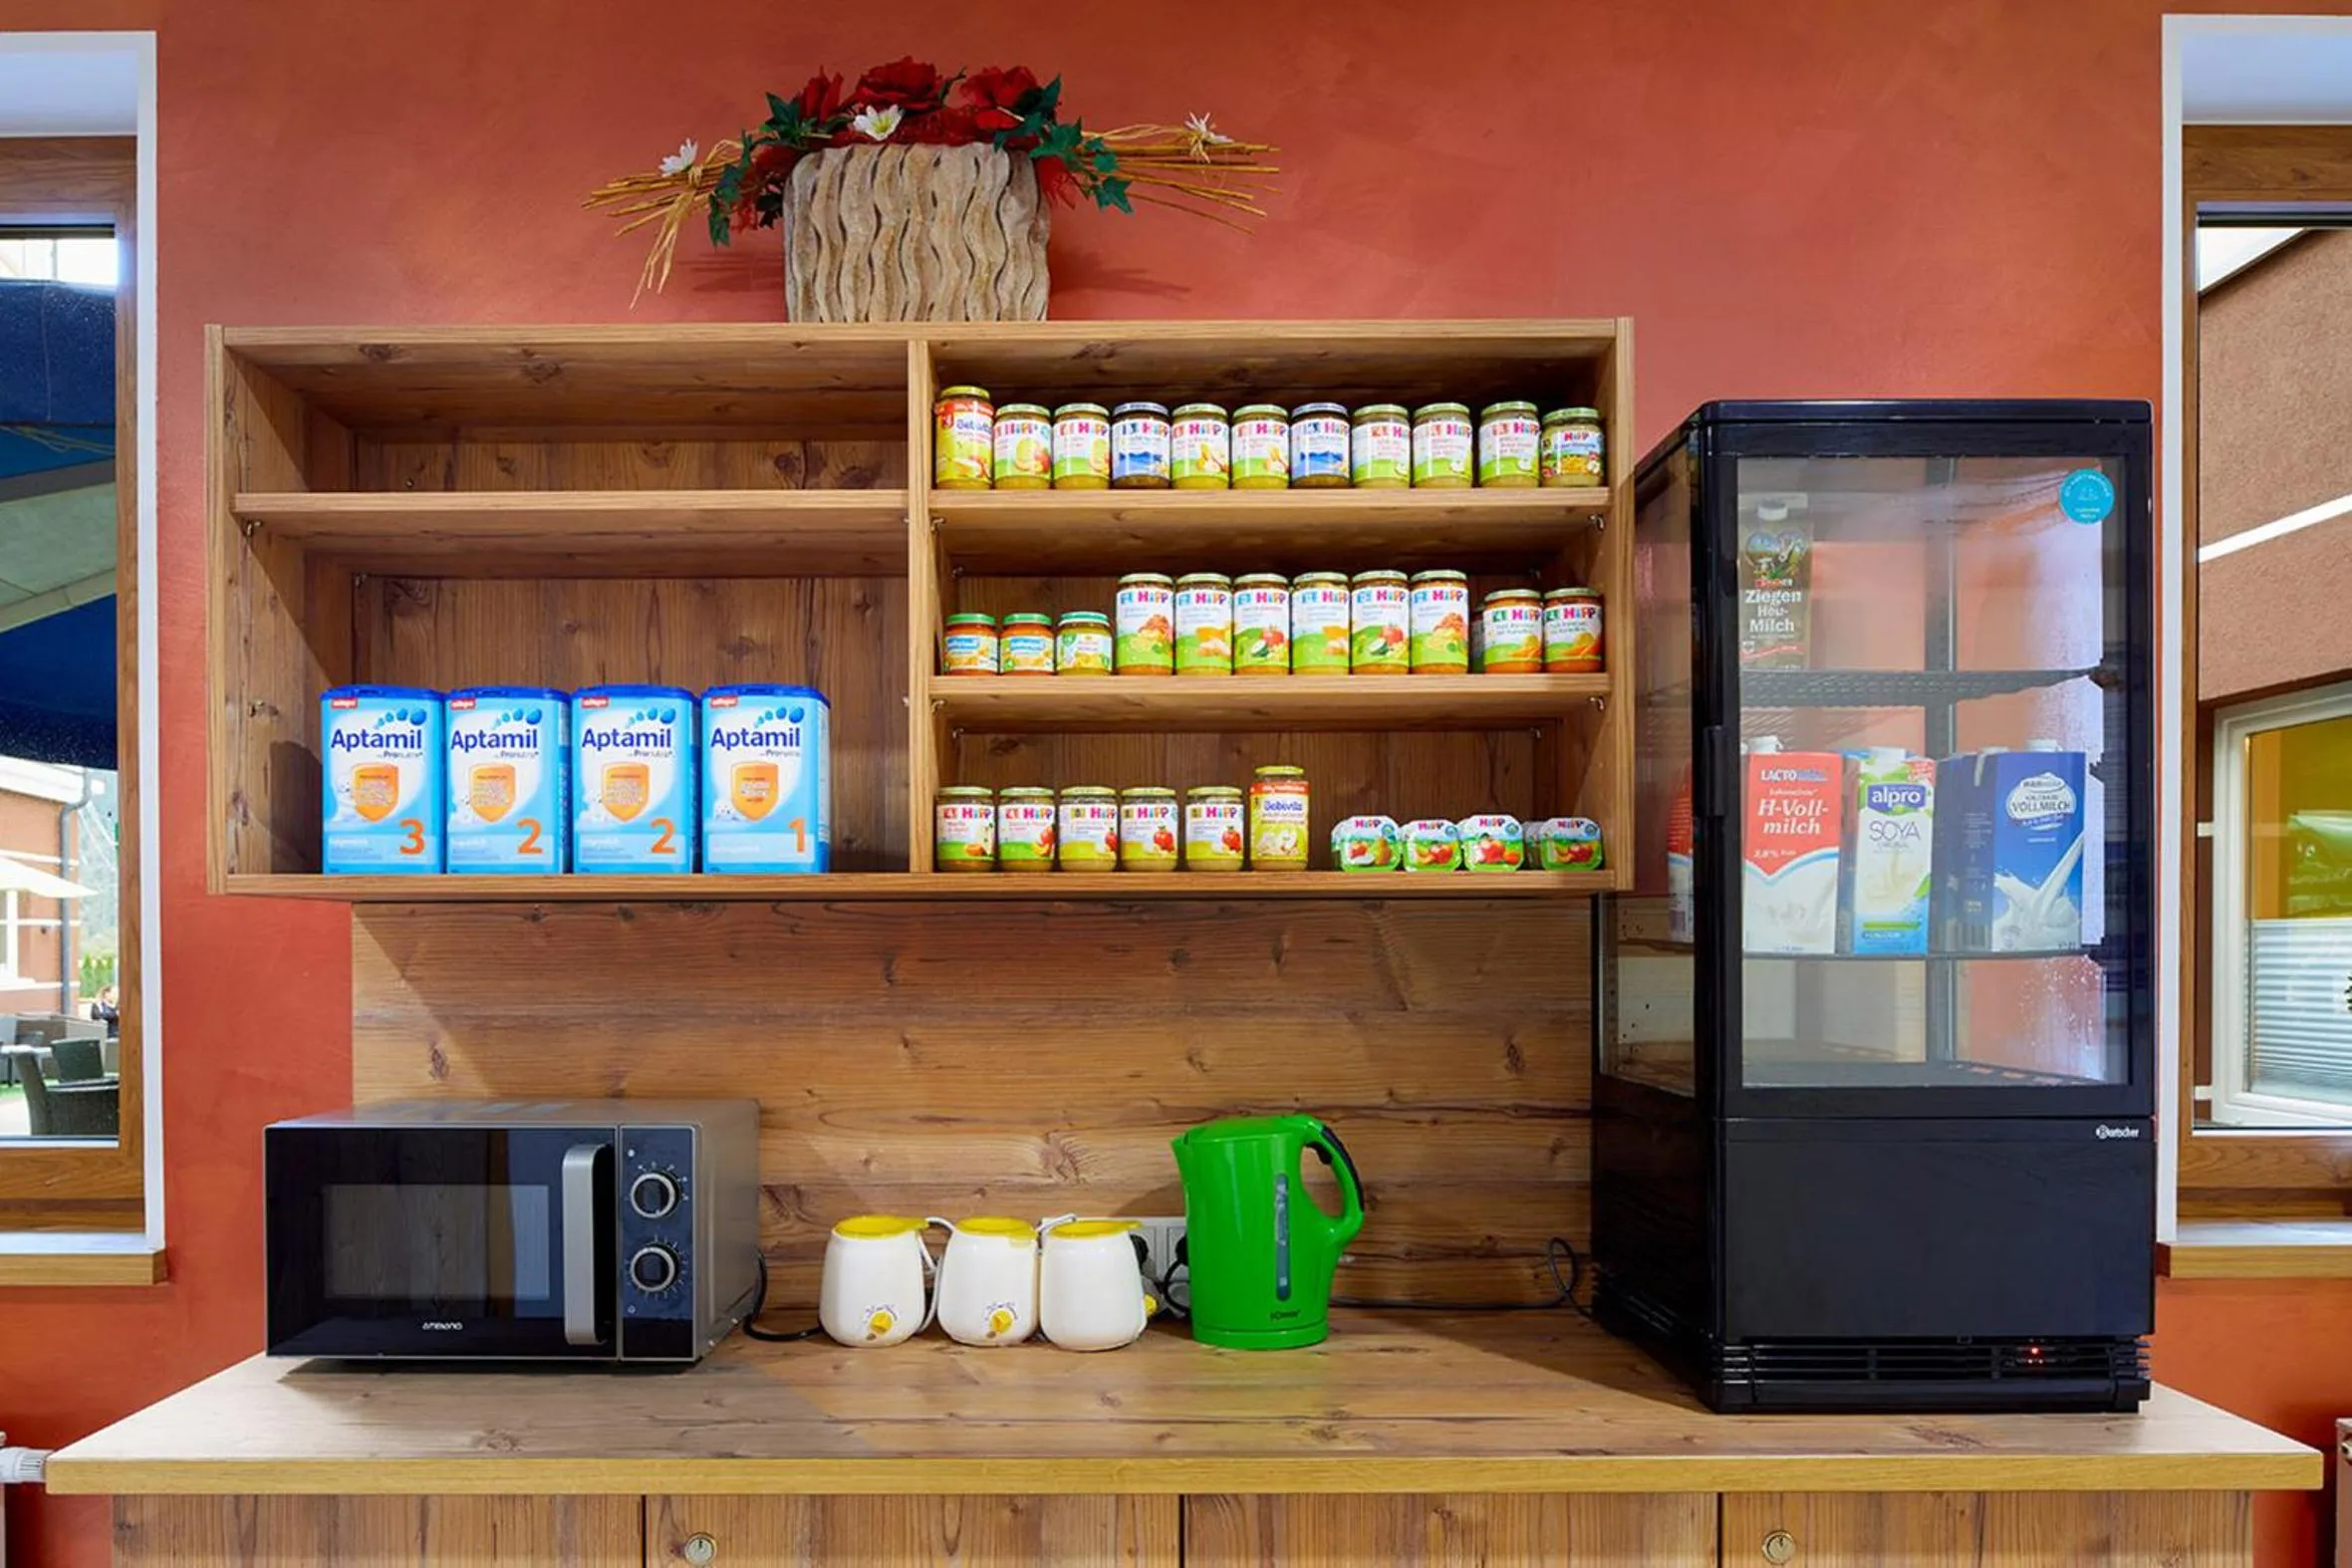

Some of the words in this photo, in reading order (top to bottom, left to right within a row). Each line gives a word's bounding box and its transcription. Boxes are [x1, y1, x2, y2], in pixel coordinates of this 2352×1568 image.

[1745, 589, 1802, 607] Ziegen
[1749, 618, 1795, 633] Milch
[331, 728, 421, 752] Aptamil
[450, 728, 538, 753] Aptamil
[582, 727, 671, 751] Aptamil
[710, 727, 801, 751] Aptamil
[1757, 798, 1829, 817] H-Voll-
[1871, 785, 1922, 808] alpro
[399, 818, 425, 855] 3
[517, 818, 543, 855] 2
[651, 817, 676, 855] 2
[788, 817, 806, 854] 1
[1762, 817, 1821, 835] milch
[1869, 820, 1922, 842] SOYA
